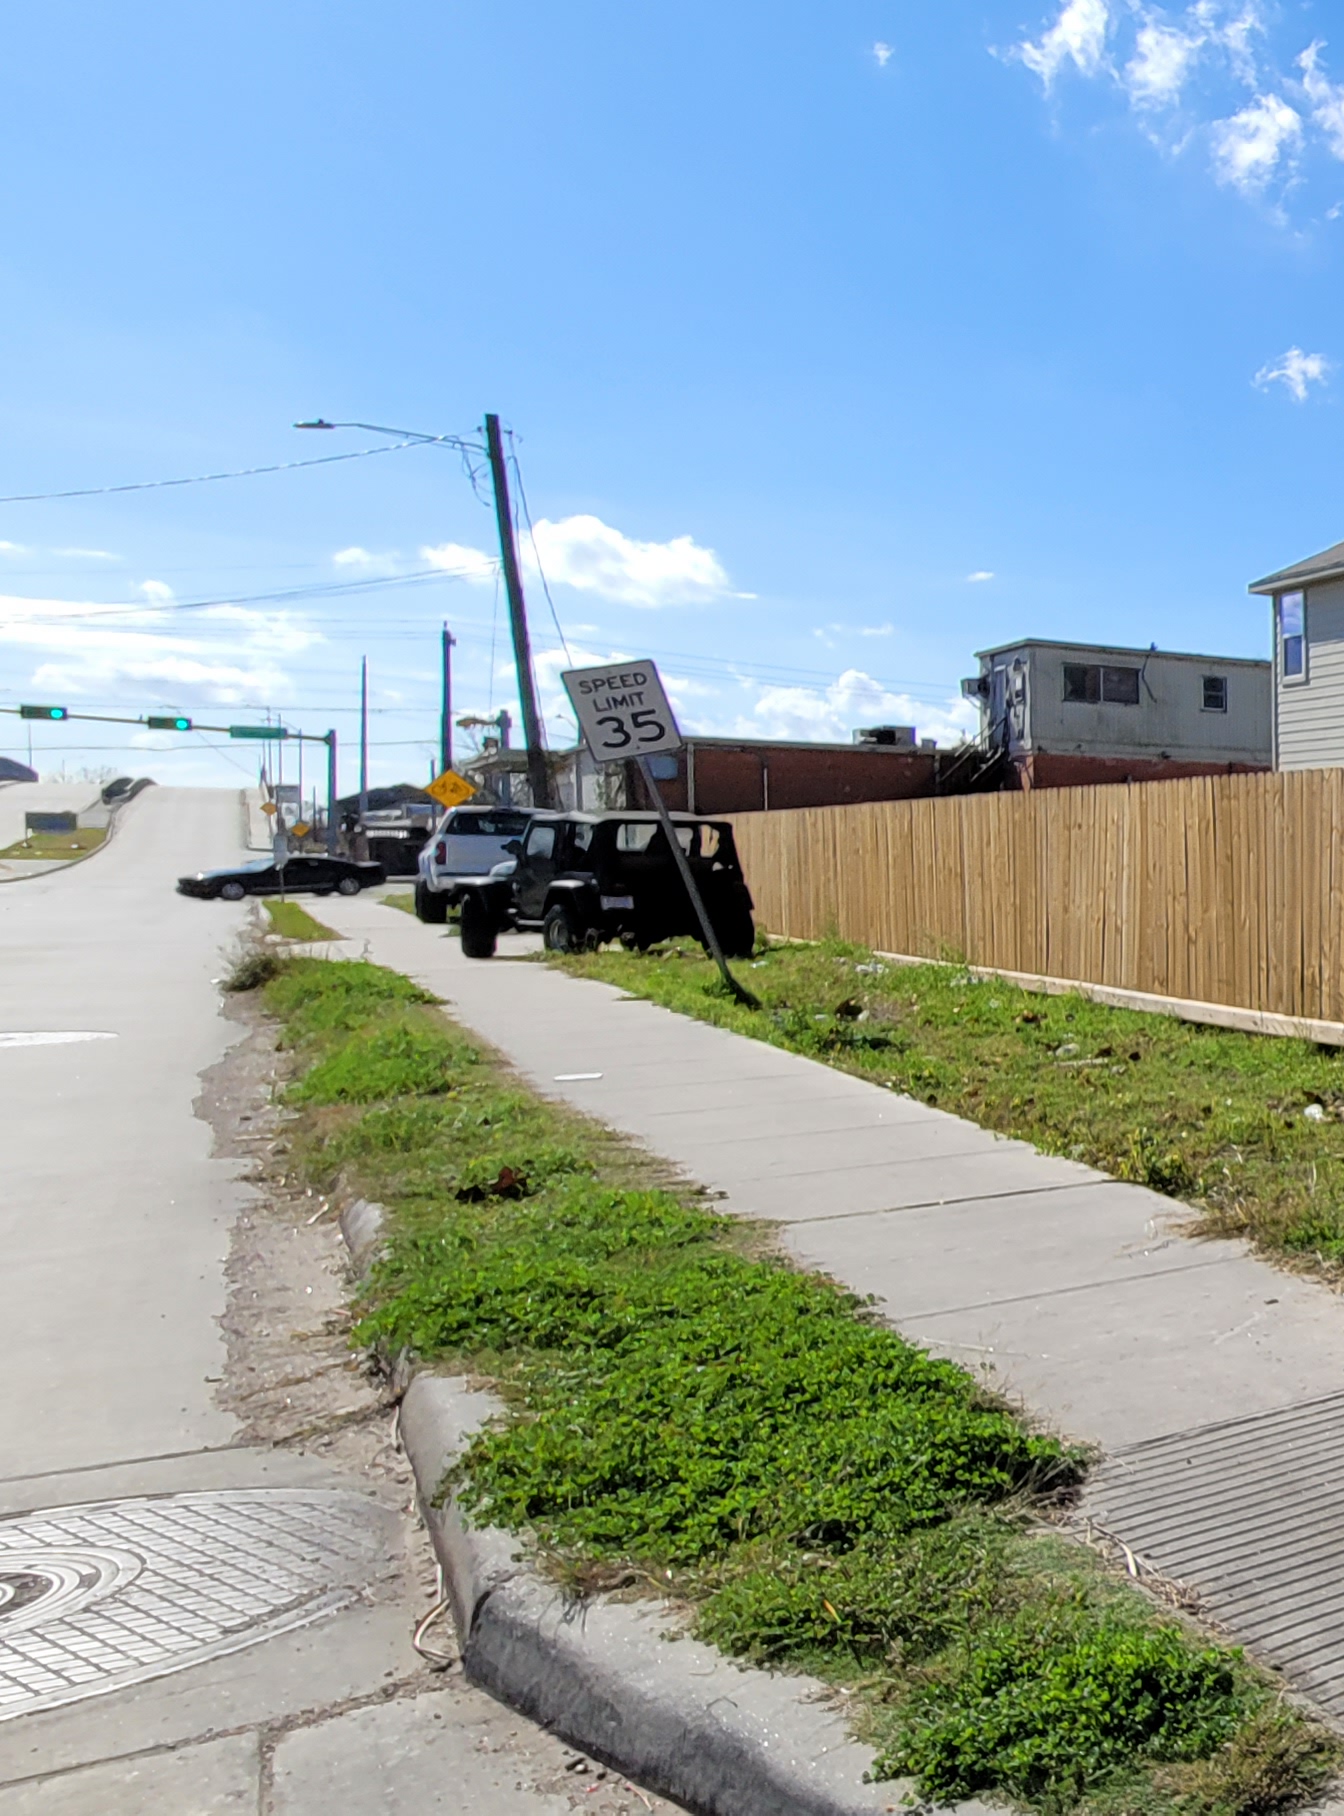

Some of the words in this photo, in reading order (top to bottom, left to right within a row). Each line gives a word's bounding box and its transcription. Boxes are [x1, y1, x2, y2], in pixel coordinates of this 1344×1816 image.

[578, 672, 647, 695] SPEED
[592, 691, 644, 712] LIMIT
[596, 708, 665, 748] 35
